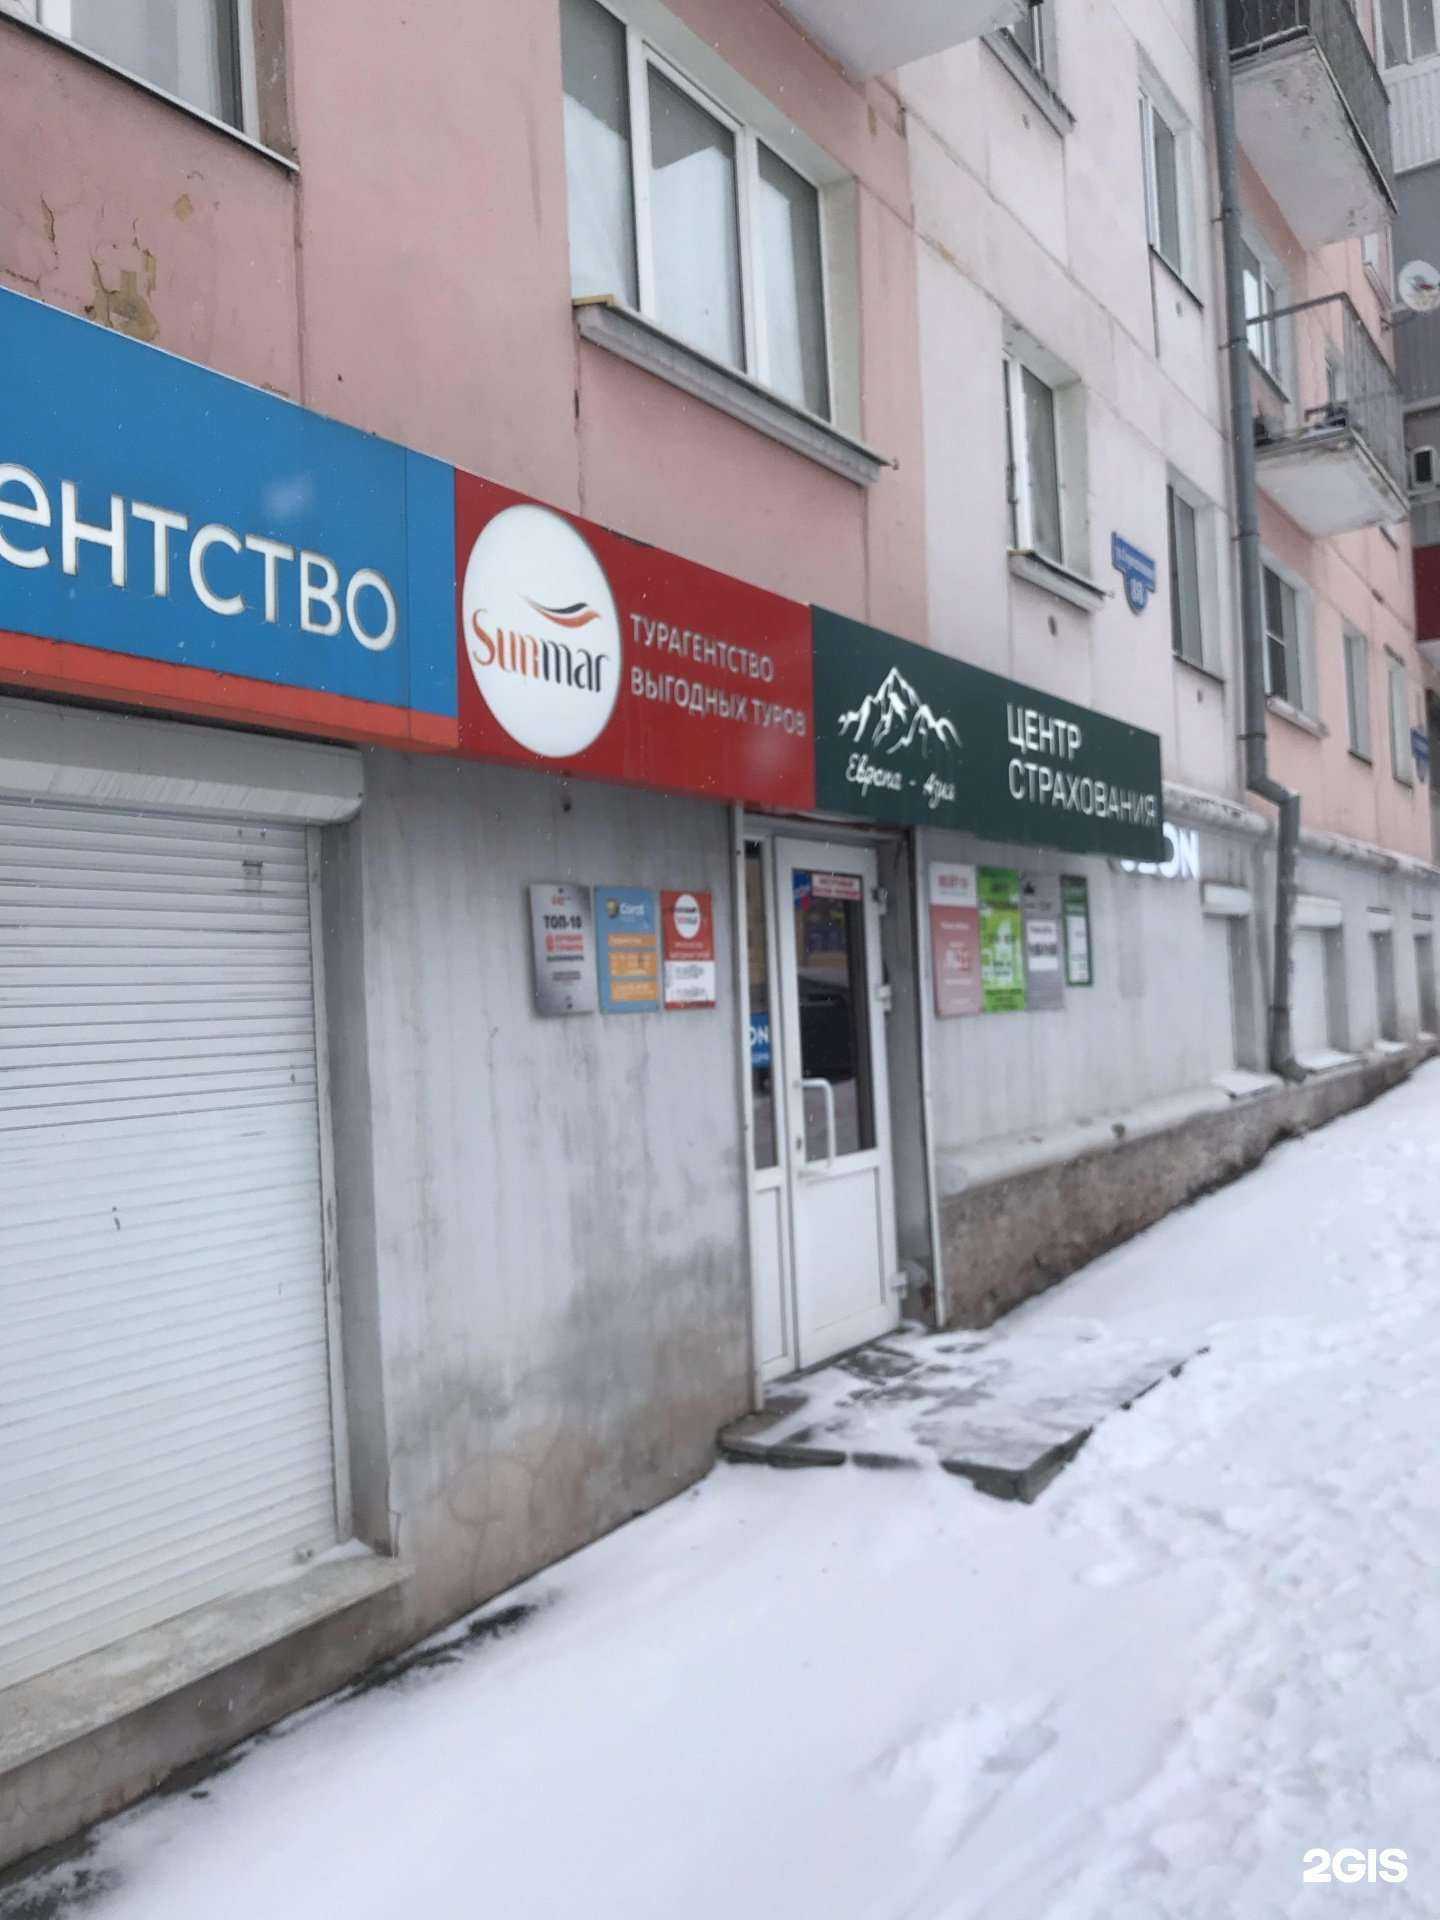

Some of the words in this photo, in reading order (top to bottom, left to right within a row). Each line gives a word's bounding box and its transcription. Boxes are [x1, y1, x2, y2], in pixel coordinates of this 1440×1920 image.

[471, 607, 611, 693] Sunmar
[629, 613, 775, 683] ТУРАГЕНТСТВО
[630, 666, 749, 723] ВЫГОДНЫХ
[751, 699, 807, 737] ТУРОВ
[1006, 703, 1083, 761] ЦЕНТР
[1008, 758, 1158, 827] СТРАХОВАНИЯ
